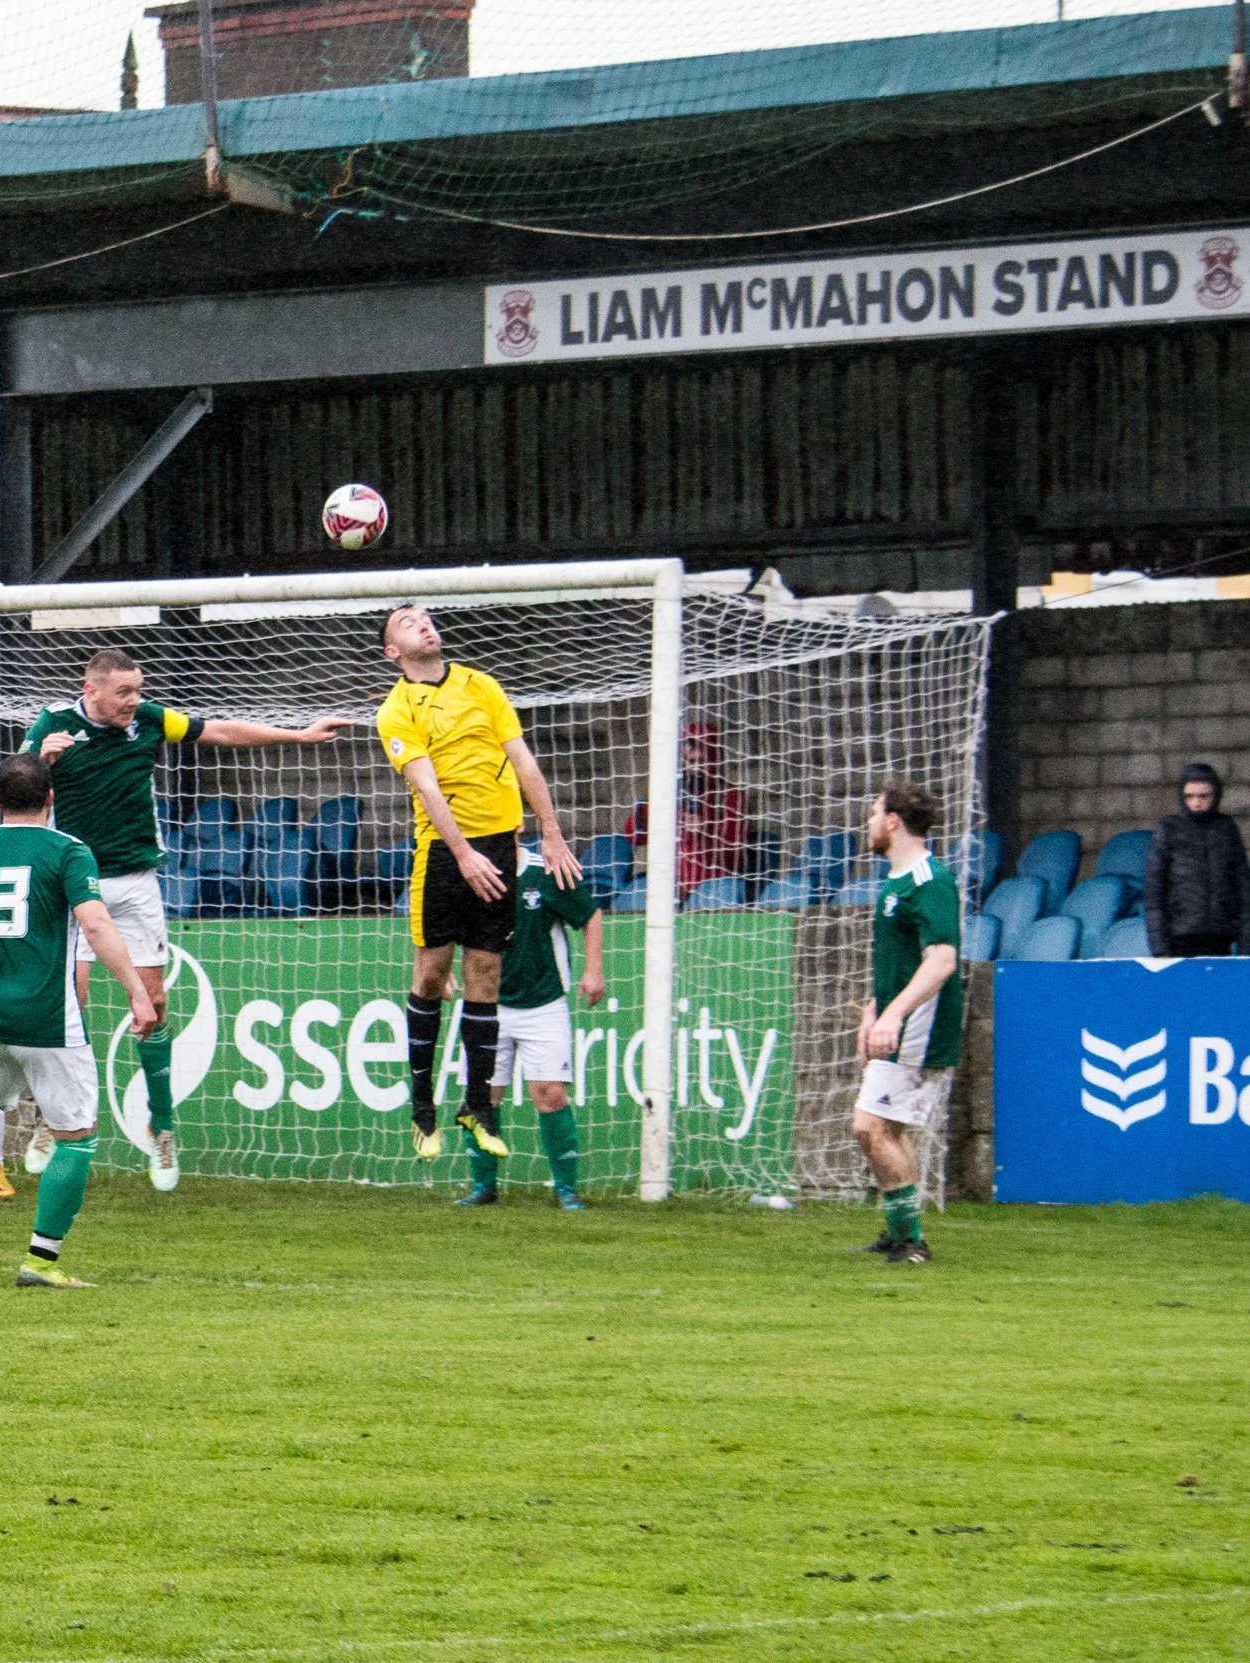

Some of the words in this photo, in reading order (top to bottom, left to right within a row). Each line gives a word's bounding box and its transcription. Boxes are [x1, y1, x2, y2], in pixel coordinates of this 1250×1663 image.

[560, 285, 682, 346] LIAM
[992, 250, 1180, 317] STAND
[232, 999, 410, 1112] sse
[1189, 1036, 1250, 1127] B
